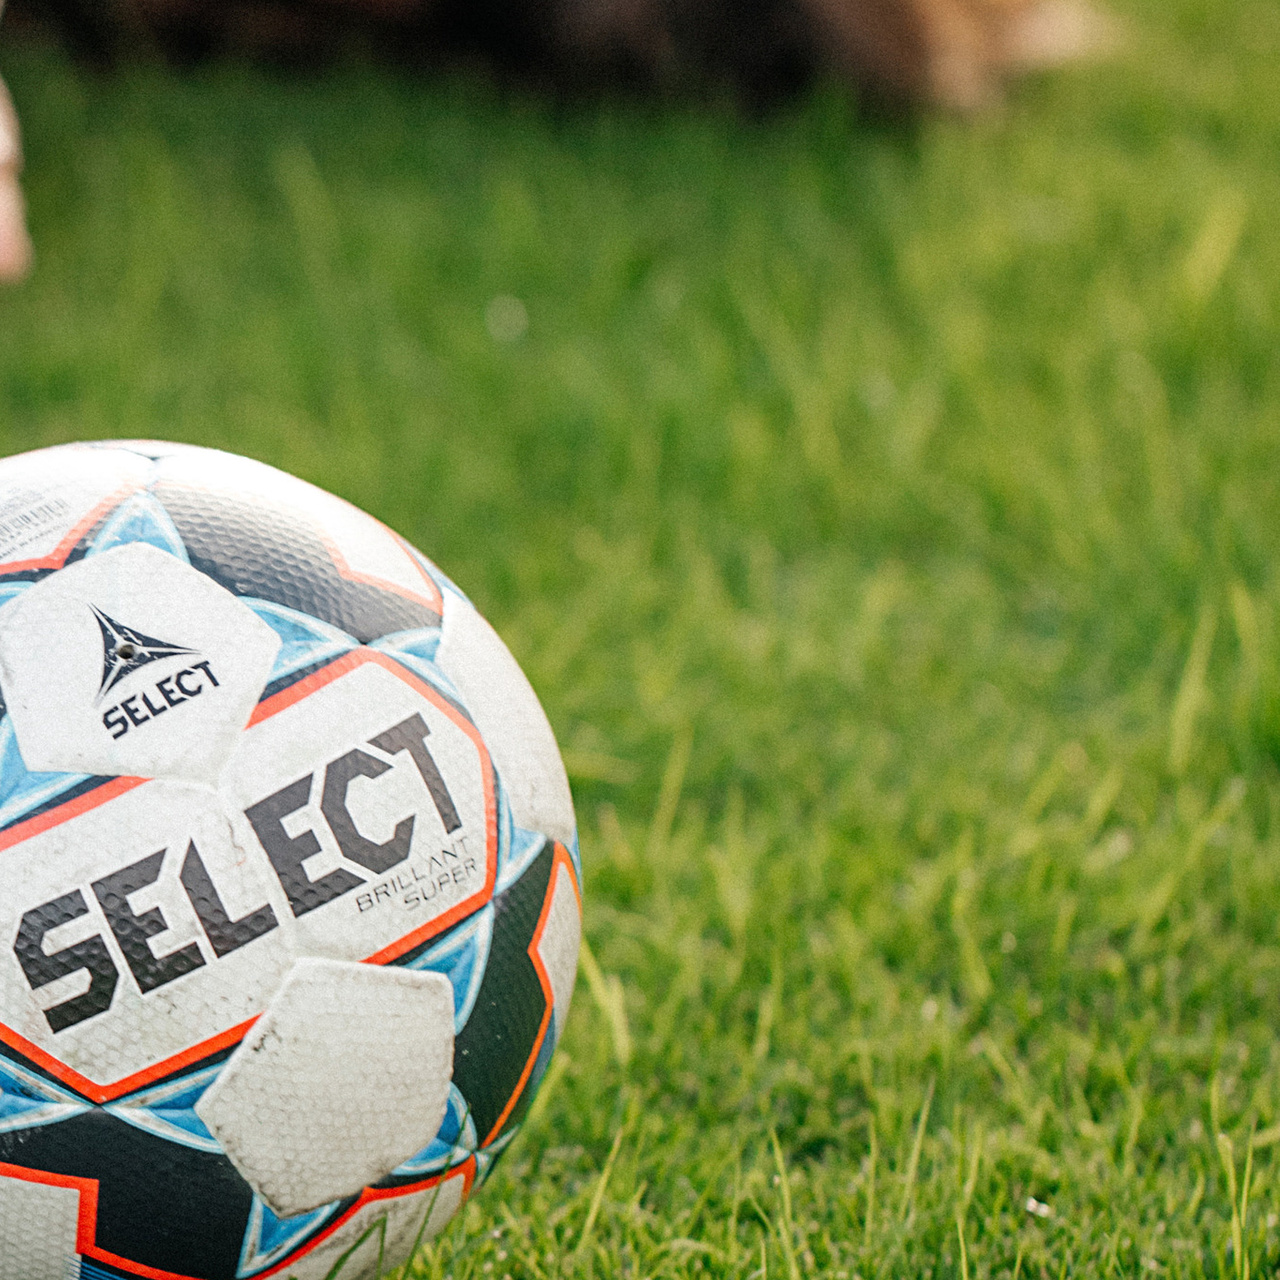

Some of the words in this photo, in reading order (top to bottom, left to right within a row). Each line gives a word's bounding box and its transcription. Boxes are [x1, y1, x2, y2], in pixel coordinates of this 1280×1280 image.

[102, 660, 221, 740] SELECT
[13, 711, 463, 1034] SELECT
[356, 838, 470, 912] BRILLANT
[404, 857, 477, 911] SUPER
